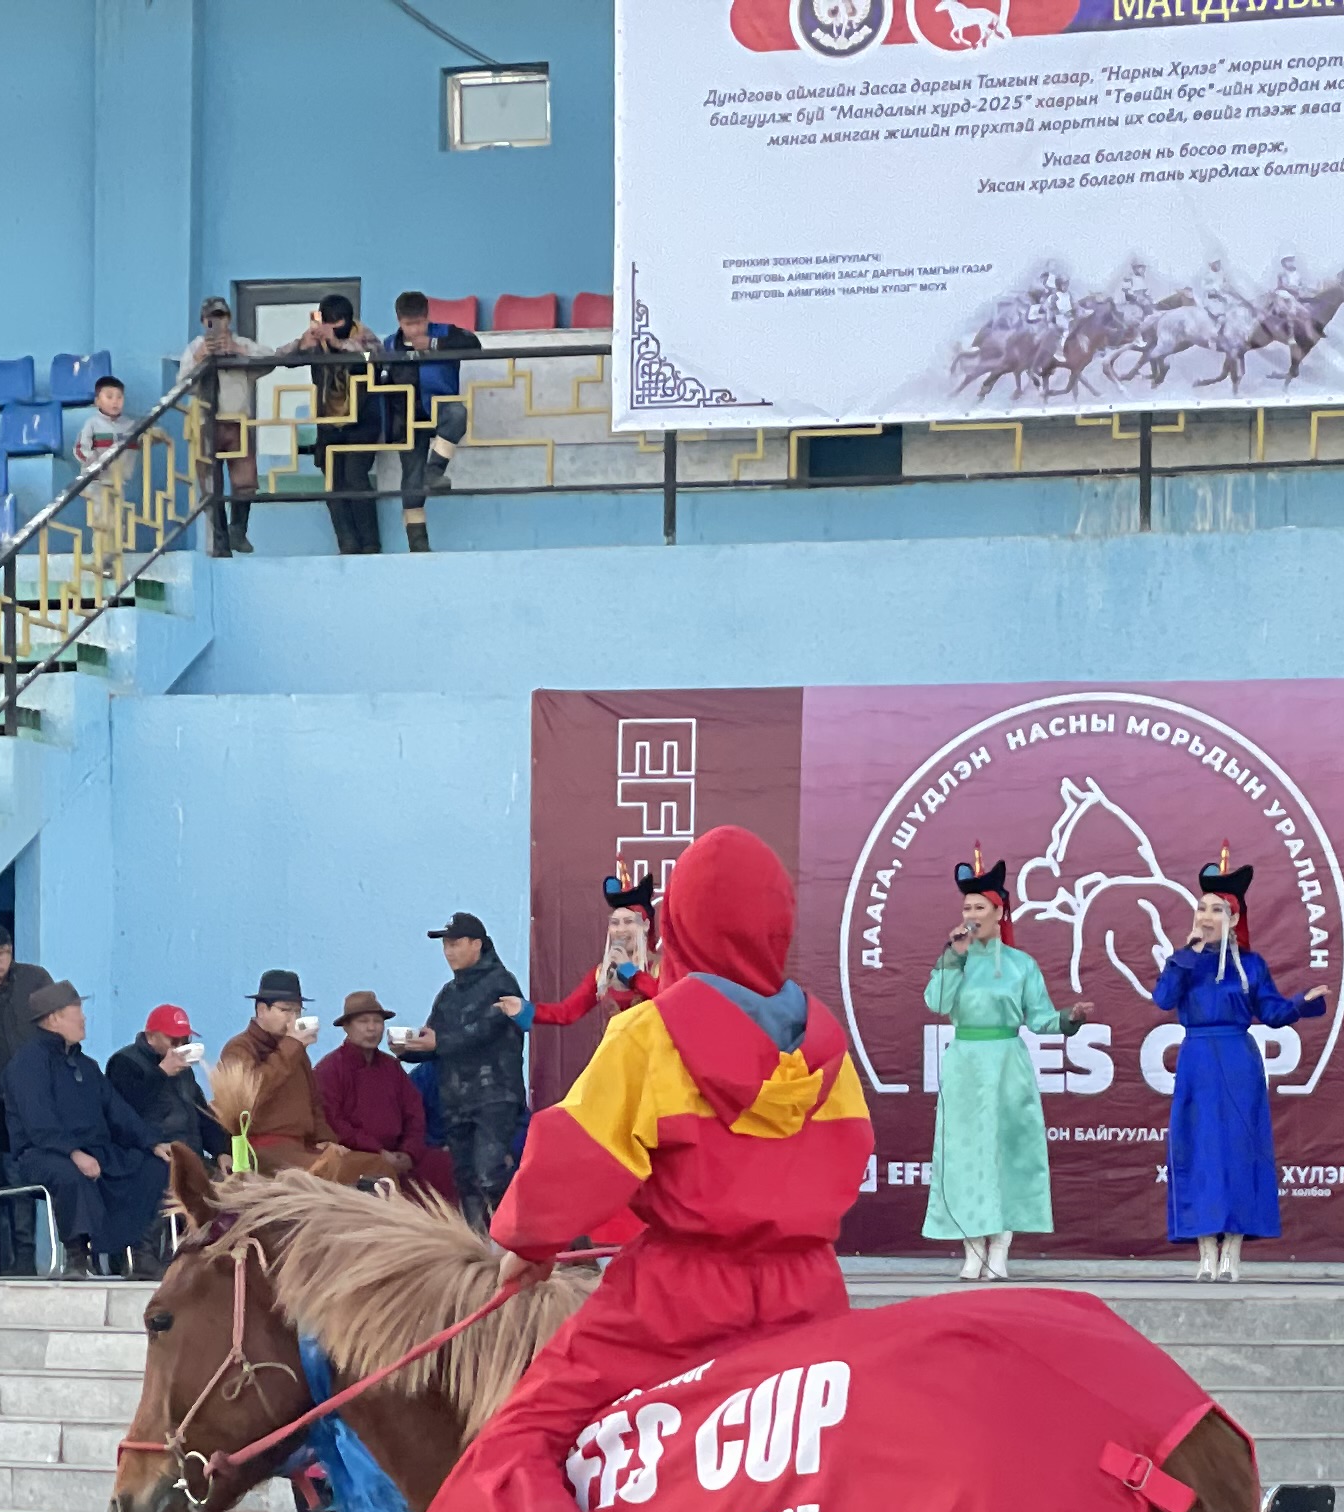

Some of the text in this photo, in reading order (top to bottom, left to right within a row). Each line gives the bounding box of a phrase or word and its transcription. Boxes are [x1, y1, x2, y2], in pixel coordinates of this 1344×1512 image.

[703, 88, 782, 106] Дундговь
[786, 83, 856, 101] аймгийн
[860, 80, 907, 95] Засаг
[910, 78, 972, 92] даргын
[977, 74, 1039, 89] Тамгын
[1043, 72, 1094, 86] газар,
[1228, 59, 1283, 74] морин
[709, 112, 792, 127] байгуулж
[796, 106, 825, 124] буй
[1035, 94, 1099, 111] хаврын
[1258, 77, 1320, 97] хурдан
[767, 133, 817, 146] мянга
[820, 129, 880, 143] мянган
[884, 123, 950, 140] жилийн
[1038, 116, 1120, 134] морьтны
[1124, 113, 1144, 126] их
[1147, 108, 1188, 124] соёл,
[1192, 105, 1242, 121] өвийг
[1245, 104, 1297, 118] тээж
[1300, 102, 1341, 115] яваа
[1042, 141, 1288, 168] Унага болгон нь босоо төрж,
[977, 178, 1026, 193] Уясан
[1079, 172, 1135, 188] болгон
[1139, 170, 1185, 183] тань
[1188, 164, 1260, 183] хурдлах
[616, 717, 697, 905] EFE
[862, 713, 1329, 969] ДААГА, ШҮДЛЭН НАСНЫ МОРЬДЫН УРАЛДААН
[1139, 1023, 1302, 1095] CP
[1074, 1124, 1169, 1142] БАЙГУУЛАГ
[887, 1161, 933, 1185] EFE
[695, 1360, 851, 1490] CUP
